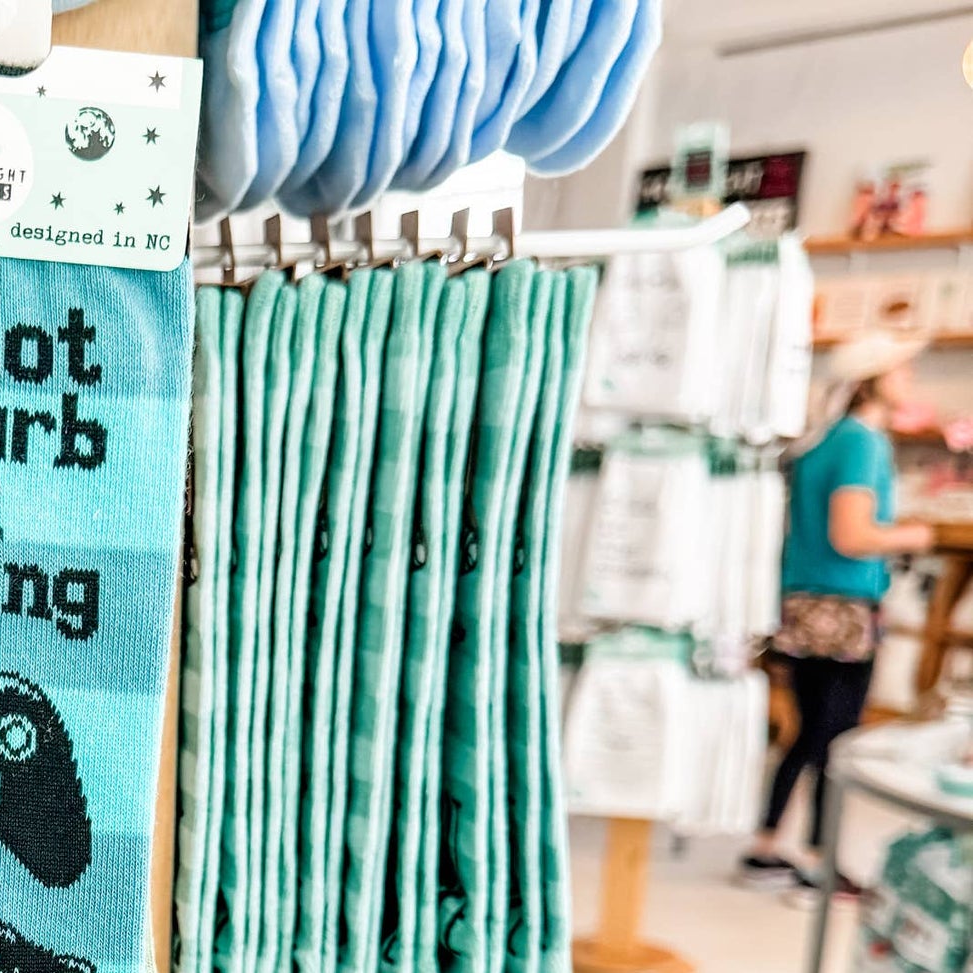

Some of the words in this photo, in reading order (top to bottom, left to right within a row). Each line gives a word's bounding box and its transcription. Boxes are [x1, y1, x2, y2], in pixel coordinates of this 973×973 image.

[10, 222, 104, 246] designed
[113, 231, 136, 248] in
[145, 233, 171, 251] NC
